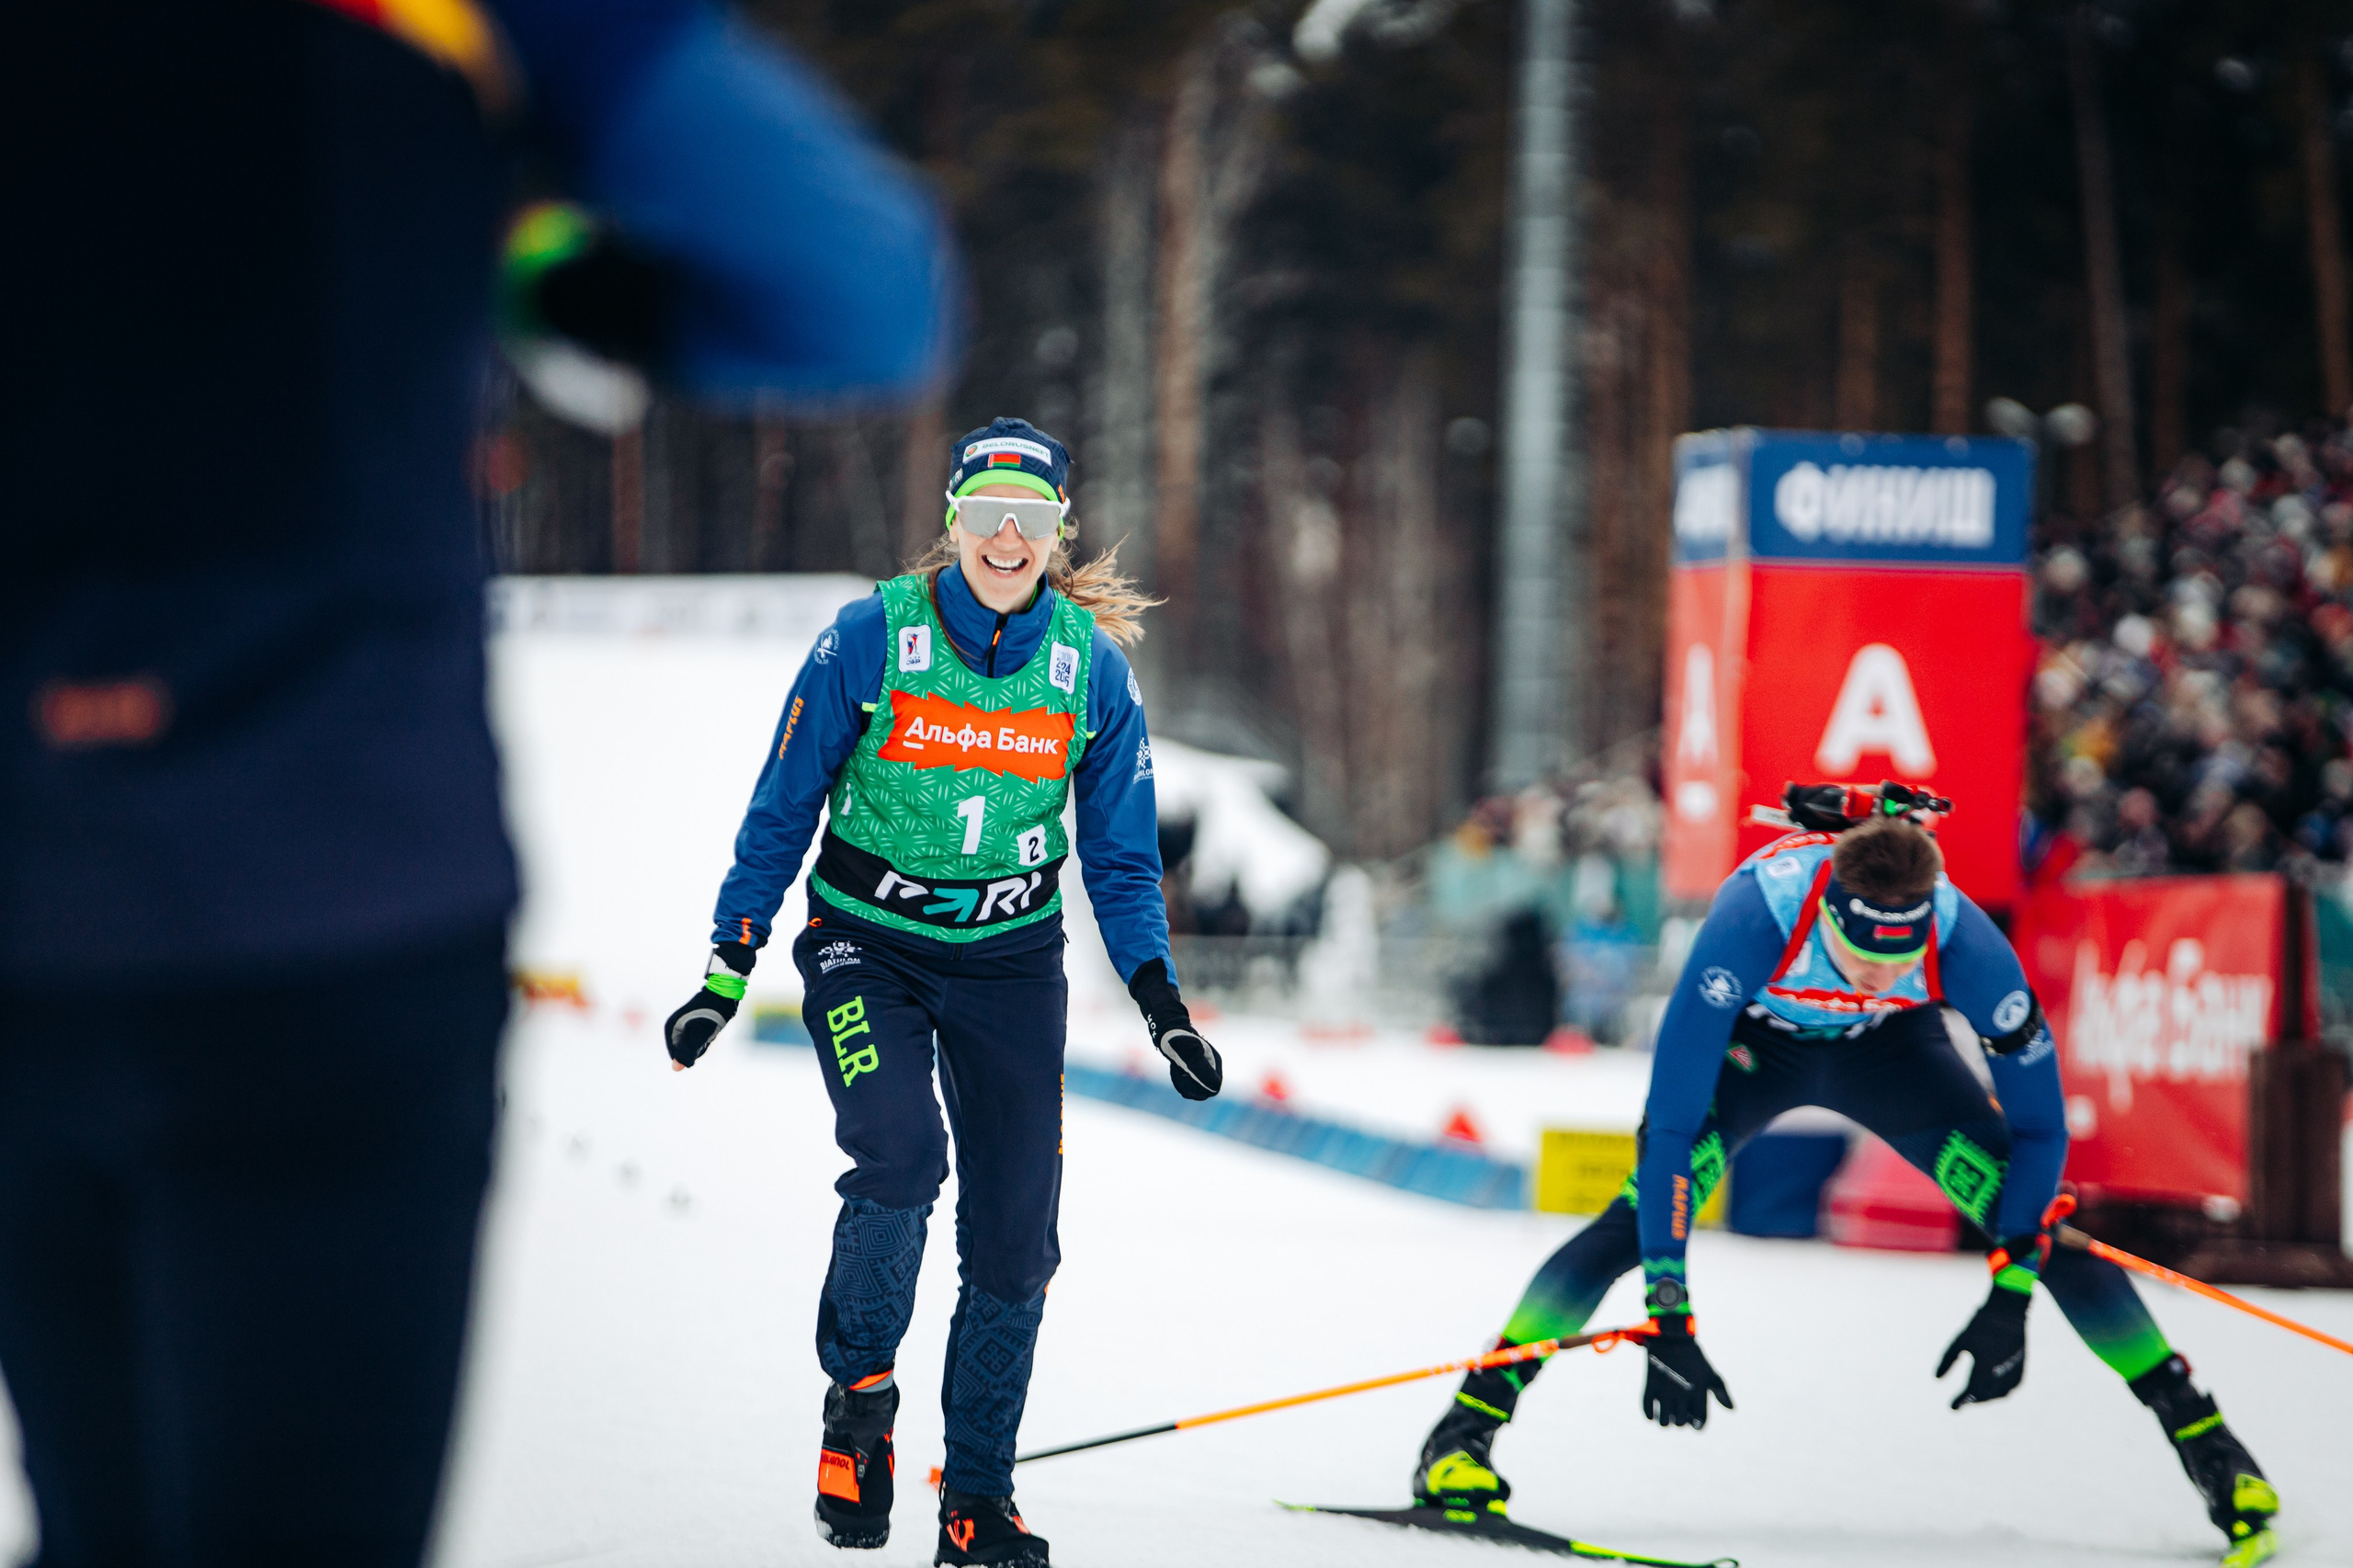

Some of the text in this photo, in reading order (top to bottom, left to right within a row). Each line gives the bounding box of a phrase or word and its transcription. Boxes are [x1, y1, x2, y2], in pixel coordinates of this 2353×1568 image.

[982, 439, 1050, 460] BELORUSNEFT
[1774, 462, 1996, 549] ФИНИШ
[903, 716, 1061, 756] Альфа Банк
[957, 795, 986, 856] 1
[1028, 835, 1040, 864] 2
[826, 995, 880, 1088] BLR
